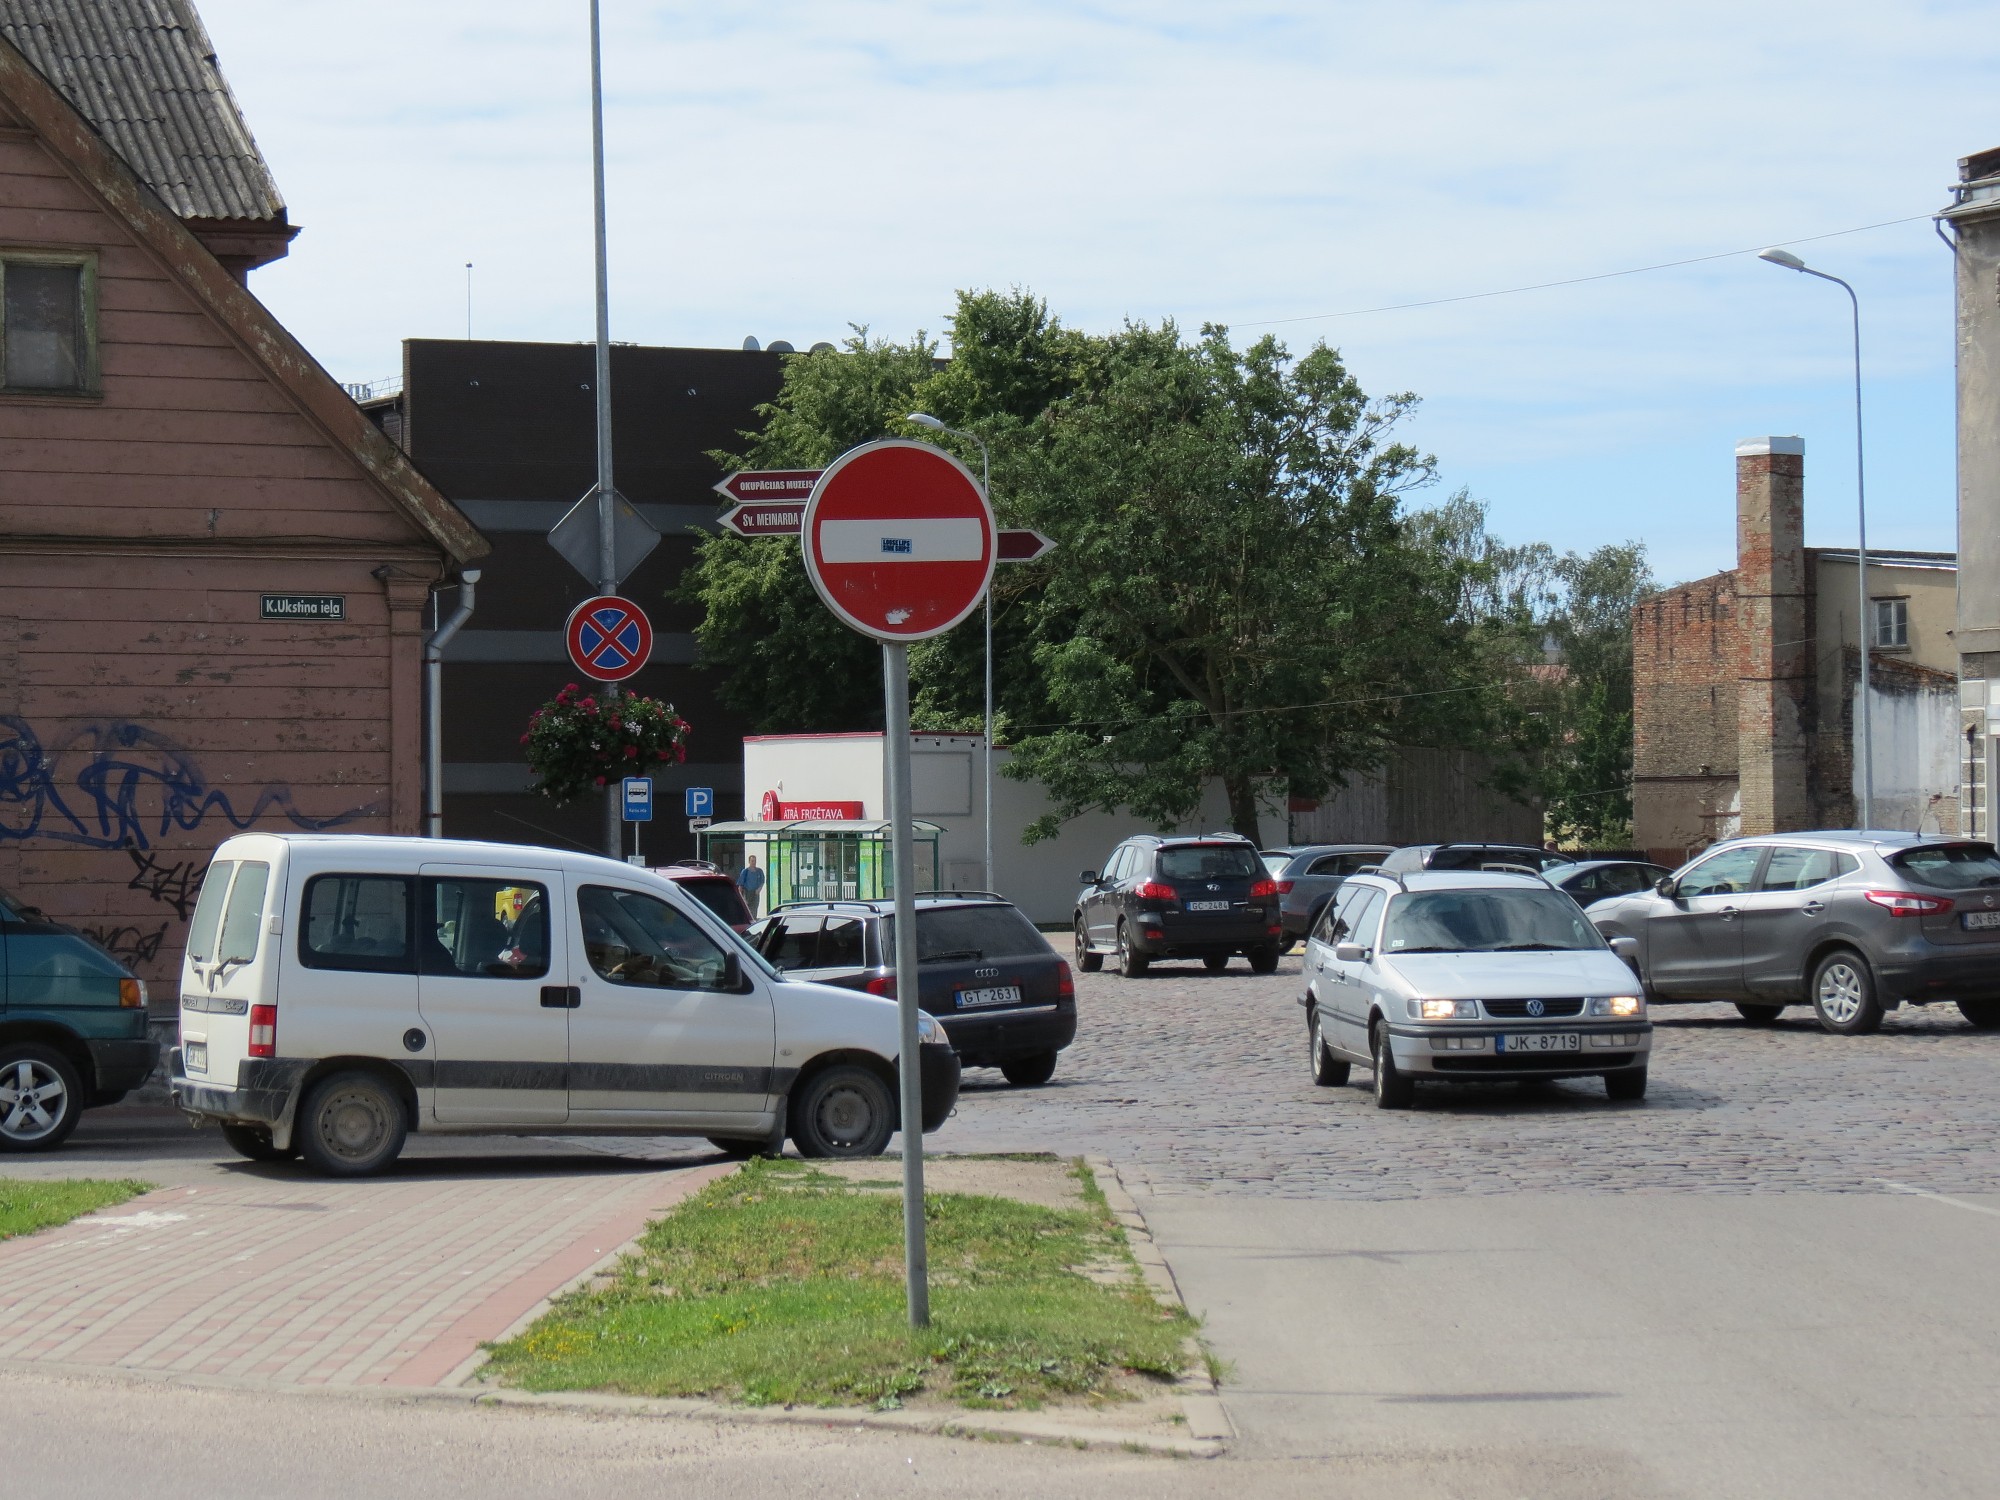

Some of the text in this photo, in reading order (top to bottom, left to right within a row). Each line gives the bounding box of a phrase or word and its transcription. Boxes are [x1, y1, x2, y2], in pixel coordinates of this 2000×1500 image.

[740, 481, 785, 490] OKUPĀCIJAS
[786, 480, 813, 489] MUZEJS
[743, 514, 755, 526] Sv.
[757, 513, 799, 526] MEINARDA
[266, 599, 340, 616] K.Ukstiņa iela
[783, 806, 843, 820] ĀTRĀ FRIZĒTAVA
[1192, 900, 1229, 910] GC-2484
[964, 988, 1019, 1003] GT-2631
[1509, 1035, 1577, 1050] JK-8719
